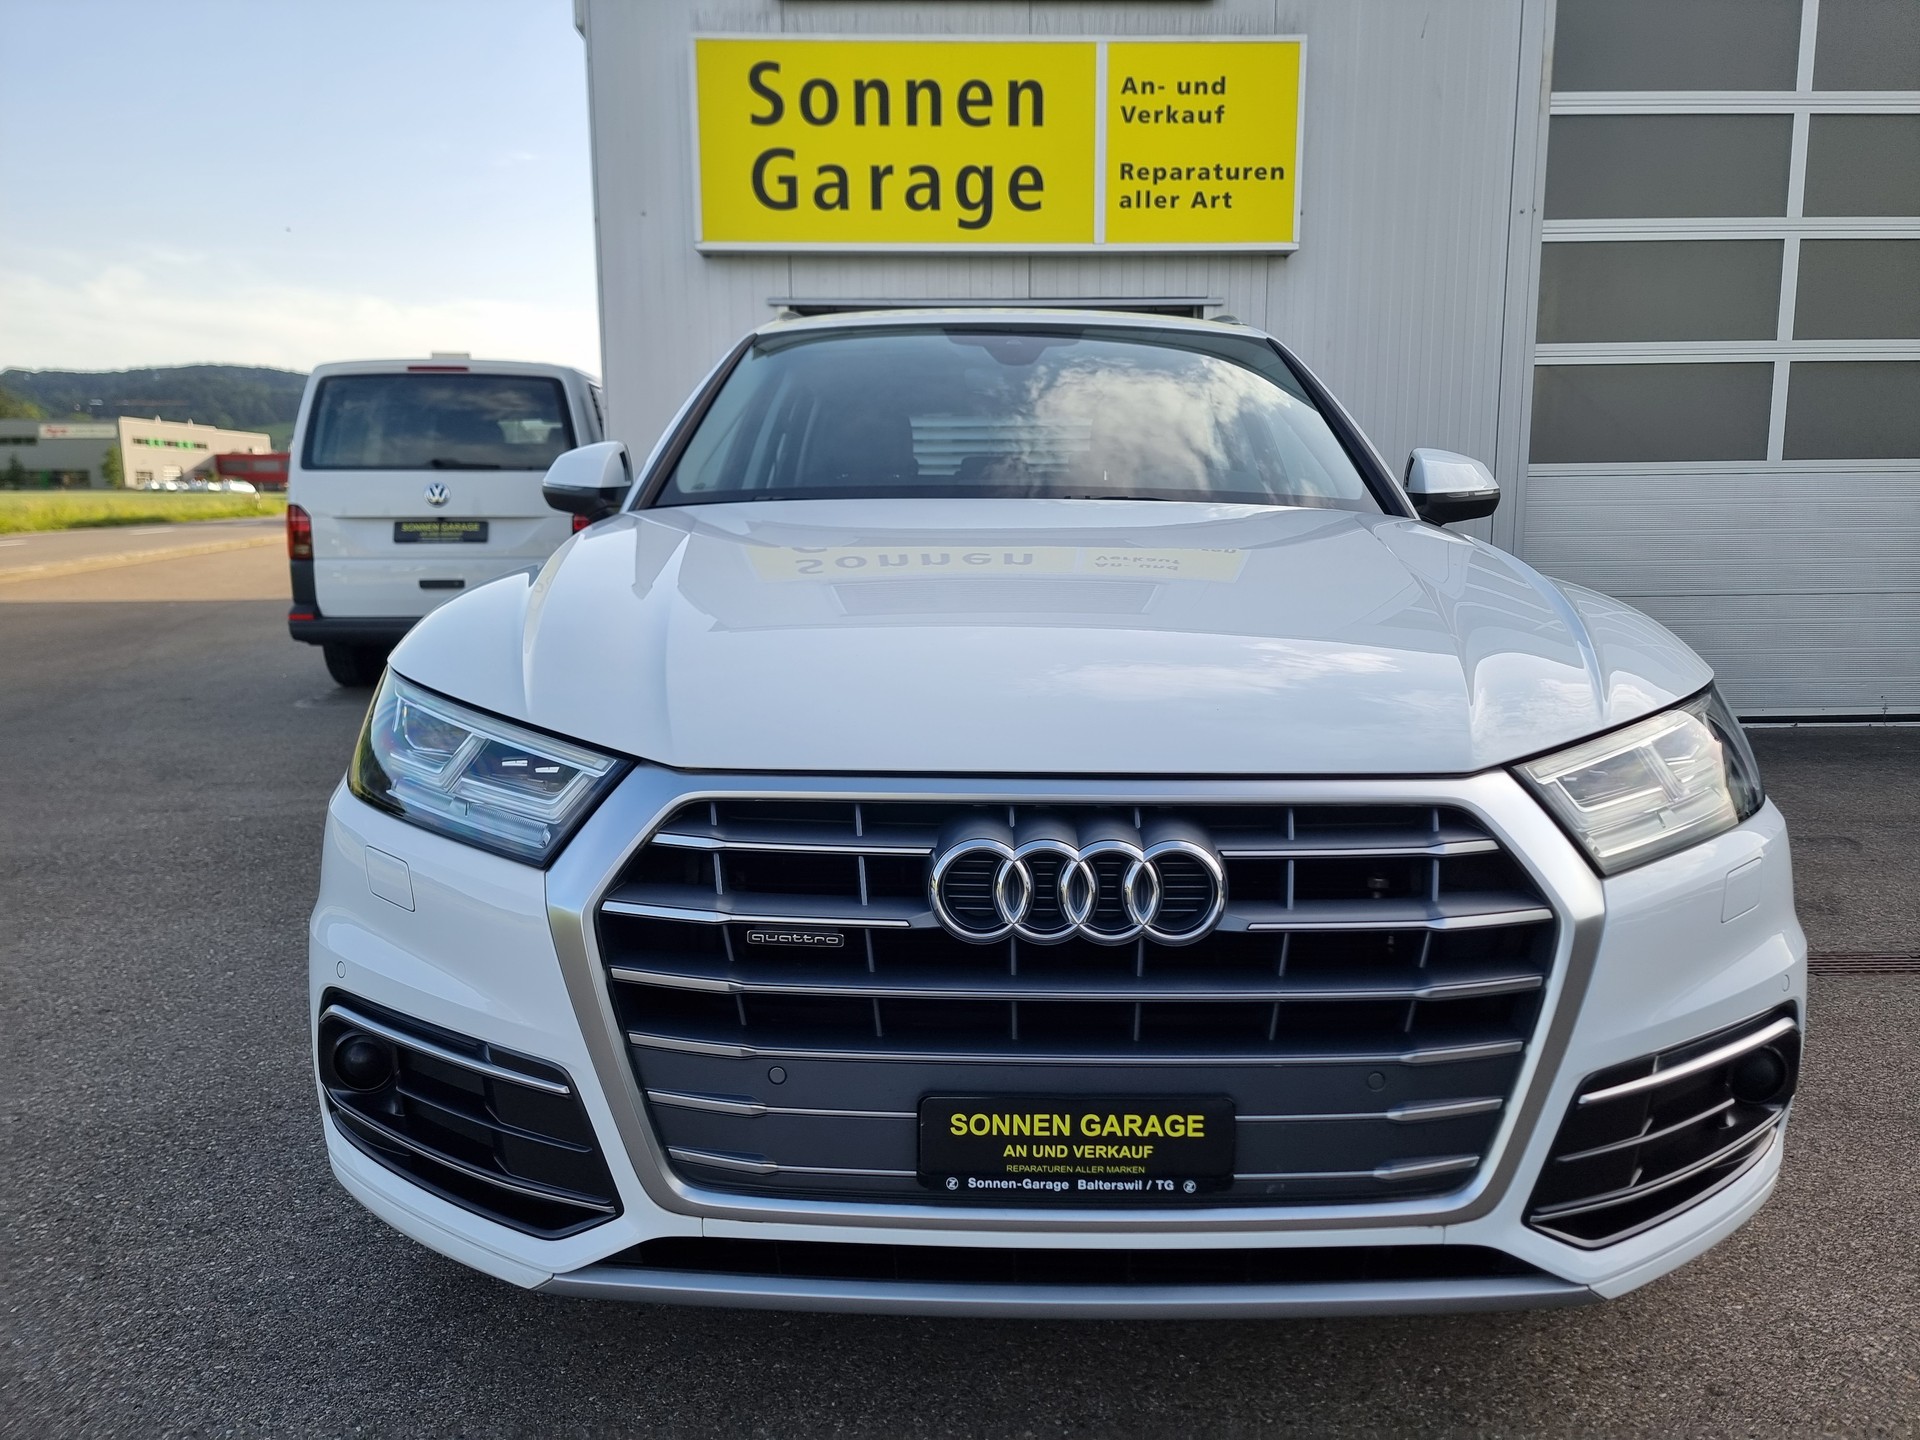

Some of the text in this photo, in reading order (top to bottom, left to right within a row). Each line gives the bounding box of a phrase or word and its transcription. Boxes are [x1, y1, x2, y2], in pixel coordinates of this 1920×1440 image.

[747, 60, 1045, 128] Sonnen
[1120, 75, 1226, 96] An- und
[1120, 104, 1225, 125] Verkauf
[1119, 162, 1285, 185] Reparaturen
[750, 147, 1045, 231] Garage
[1119, 190, 1233, 209] aller Art
[751, 933, 839, 944] quattro
[950, 1113, 1205, 1138] SONNEN GARAGE
[1002, 1144, 1154, 1159] AN UND VERKAUF
[1006, 1164, 1146, 1175] REPARATUREN ALLER MARKEN
[967, 1177, 1070, 1192] Sonnen-Garage
[1077, 1178, 1143, 1192] Balterswil
[1155, 1179, 1175, 1192] TG
